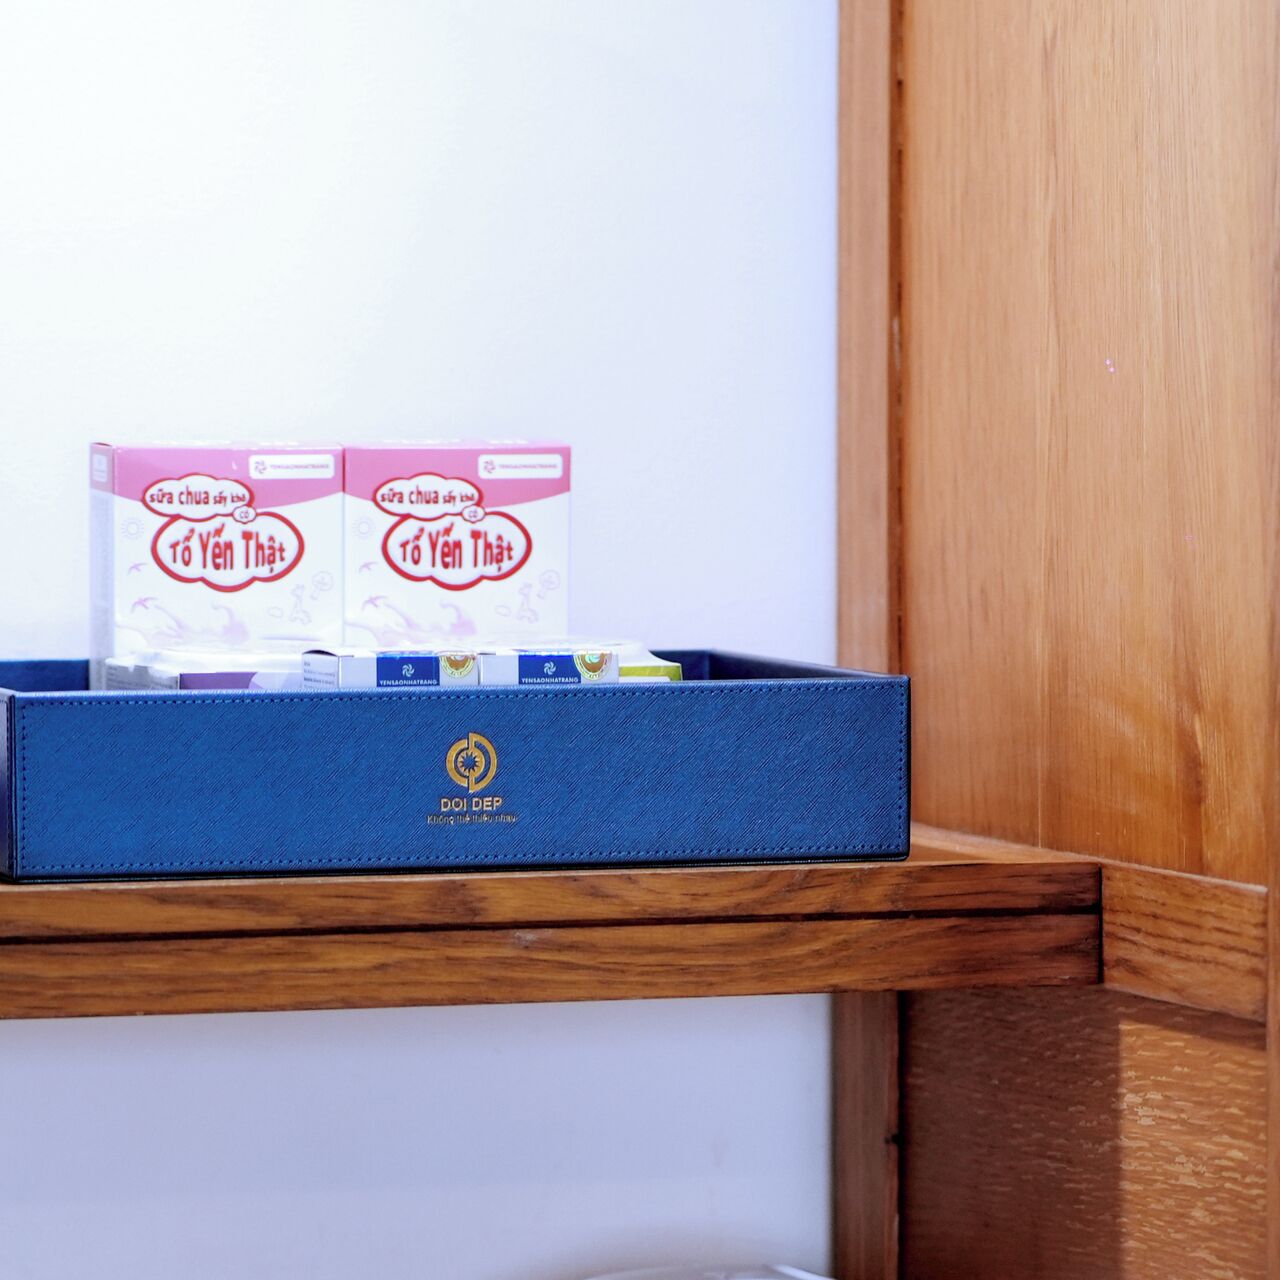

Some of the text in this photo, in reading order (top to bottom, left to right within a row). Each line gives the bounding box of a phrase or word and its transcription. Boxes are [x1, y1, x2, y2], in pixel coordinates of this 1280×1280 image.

[150, 488, 173, 504] sữa
[179, 485, 209, 504] chua
[381, 488, 404, 504] sữa
[409, 484, 438, 504] chua
[199, 522, 234, 570] Yến
[242, 530, 285, 574] Thật
[428, 522, 462, 569] Yến
[470, 530, 513, 572] Thật
[440, 797, 503, 811] DOI DEP
